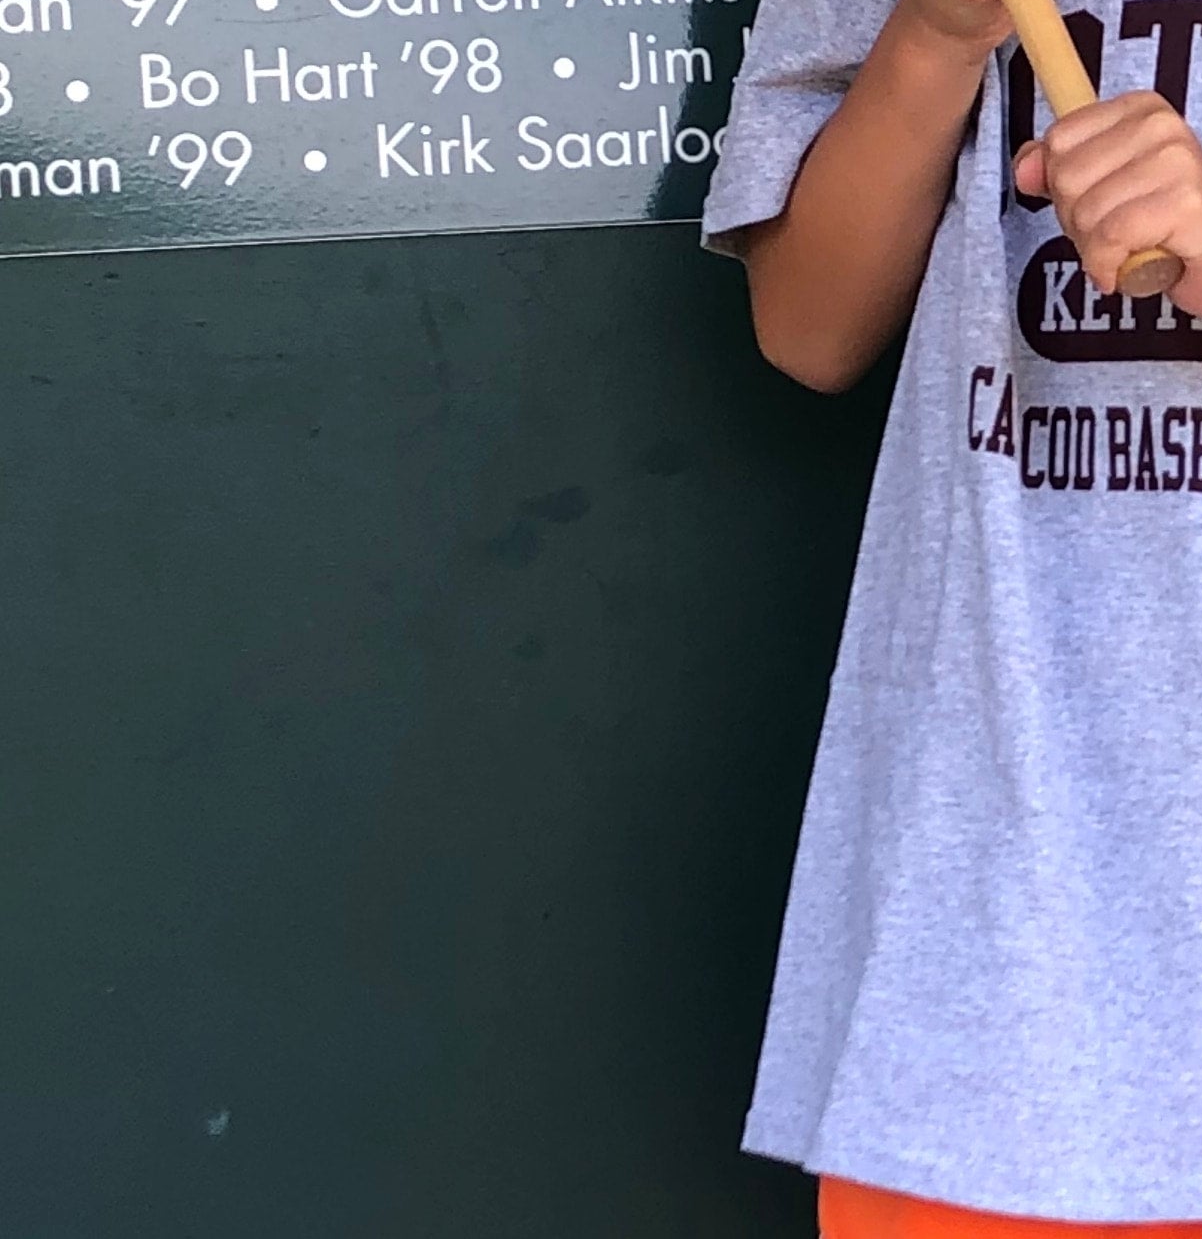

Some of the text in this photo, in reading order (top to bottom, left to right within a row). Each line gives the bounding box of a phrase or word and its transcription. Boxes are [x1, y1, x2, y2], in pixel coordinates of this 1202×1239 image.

[140, 53, 220, 109] Bo
[244, 47, 378, 104] Hart
[400, 37, 503, 95] '98
[618, 31, 713, 91] Jim
[0, 156, 122, 199] man
[147, 130, 253, 190] '99
[376, 114, 496, 178] Kirk
[1021, 406, 1096, 491] COD
